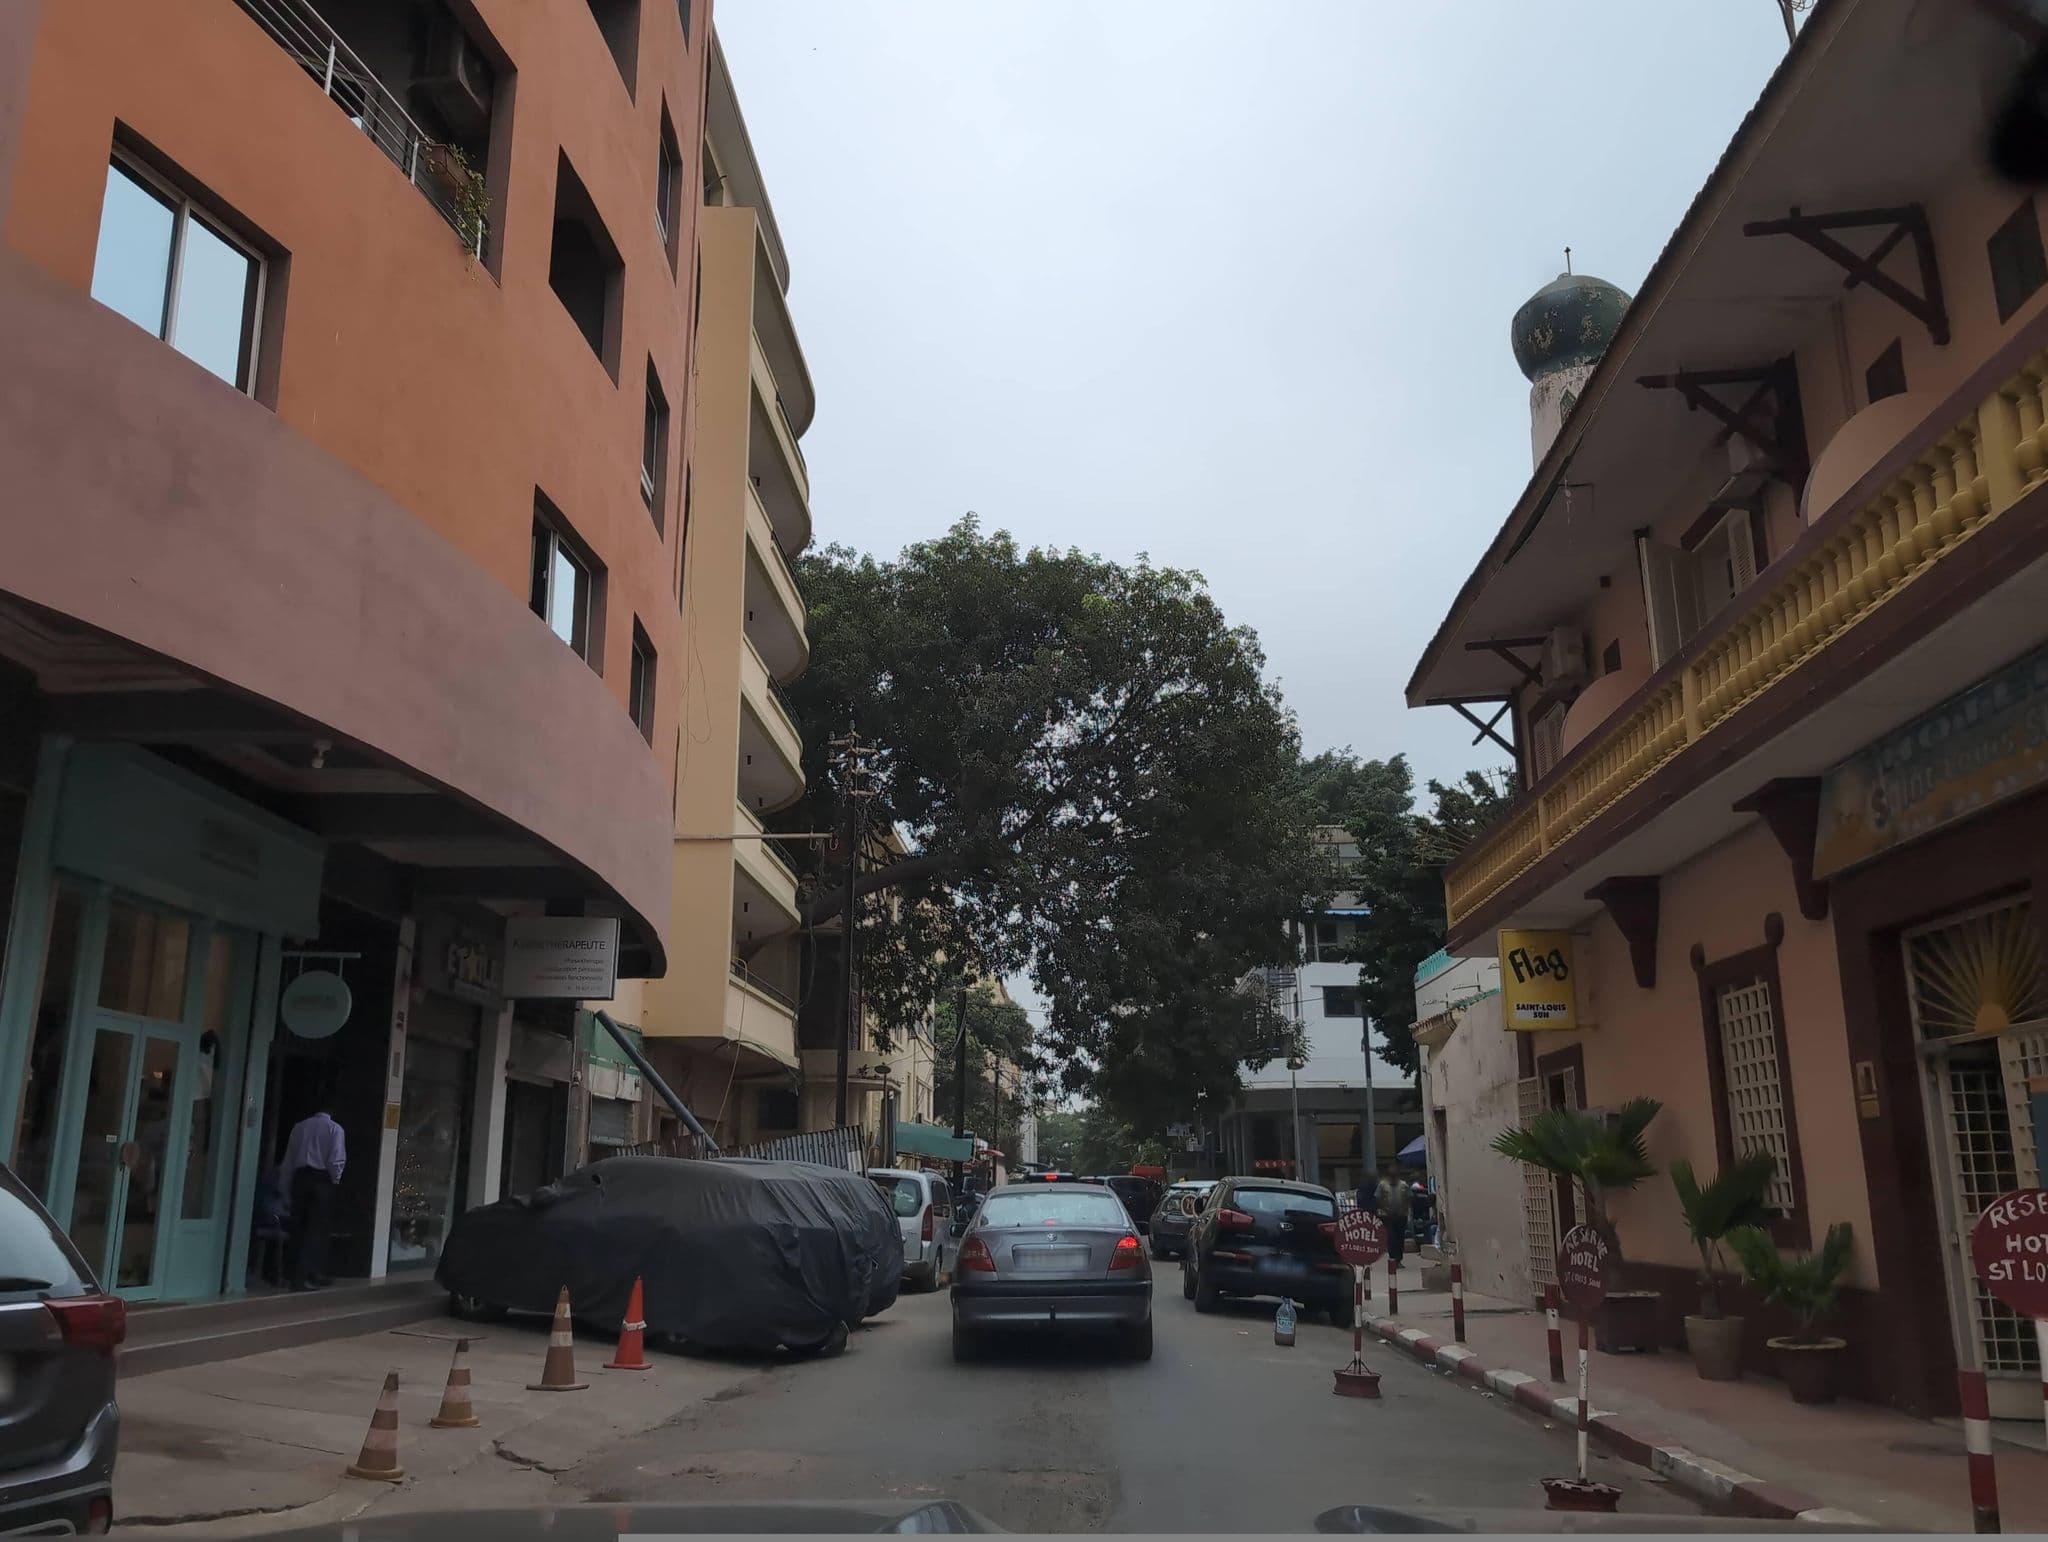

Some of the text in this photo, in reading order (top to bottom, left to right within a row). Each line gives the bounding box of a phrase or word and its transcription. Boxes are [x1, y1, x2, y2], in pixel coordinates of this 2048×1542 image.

[1508, 947, 1568, 984] Flag
[1516, 1003, 1566, 1011] SAINT-LOUIS
[1338, 1211, 1383, 1231] RESERVE
[1345, 1227, 1379, 1242] HOTEL
[1570, 1251, 1599, 1272] HOTEL
[1988, 1259, 2048, 1283] ST LO
